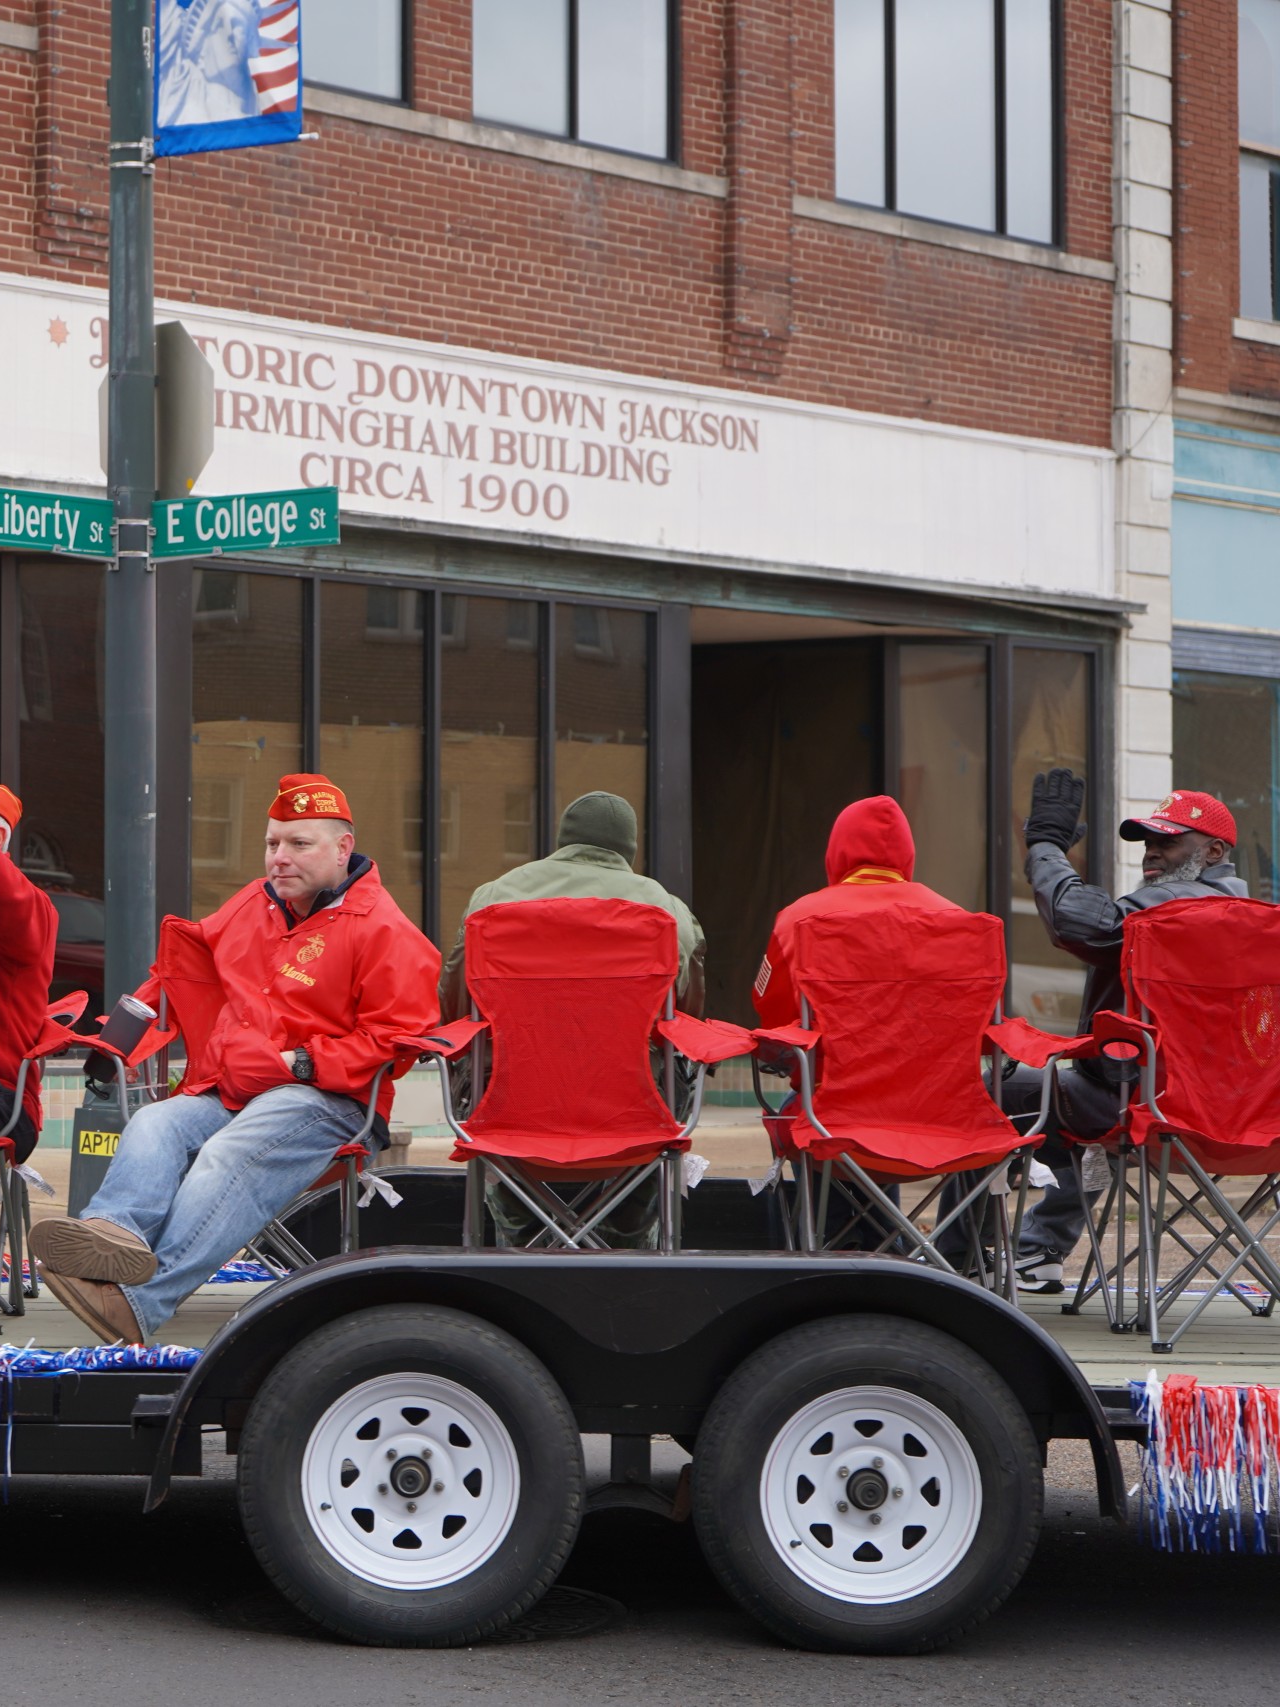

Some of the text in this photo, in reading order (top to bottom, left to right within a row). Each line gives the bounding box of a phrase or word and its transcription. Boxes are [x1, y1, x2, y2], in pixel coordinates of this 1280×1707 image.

[347, 358, 606, 432] DOWNTOWN
[619, 401, 760, 453] JACKSON
[214, 388, 671, 487] IRMINGHAM BUILDING
[299, 452, 570, 522] CIRCA 1900
[89, 521, 104, 544] St
[166, 497, 326, 548] E College St
[311, 791, 337, 801] MARINE
[314, 805, 341, 813] LEAGUE
[279, 962, 317, 987] Marines
